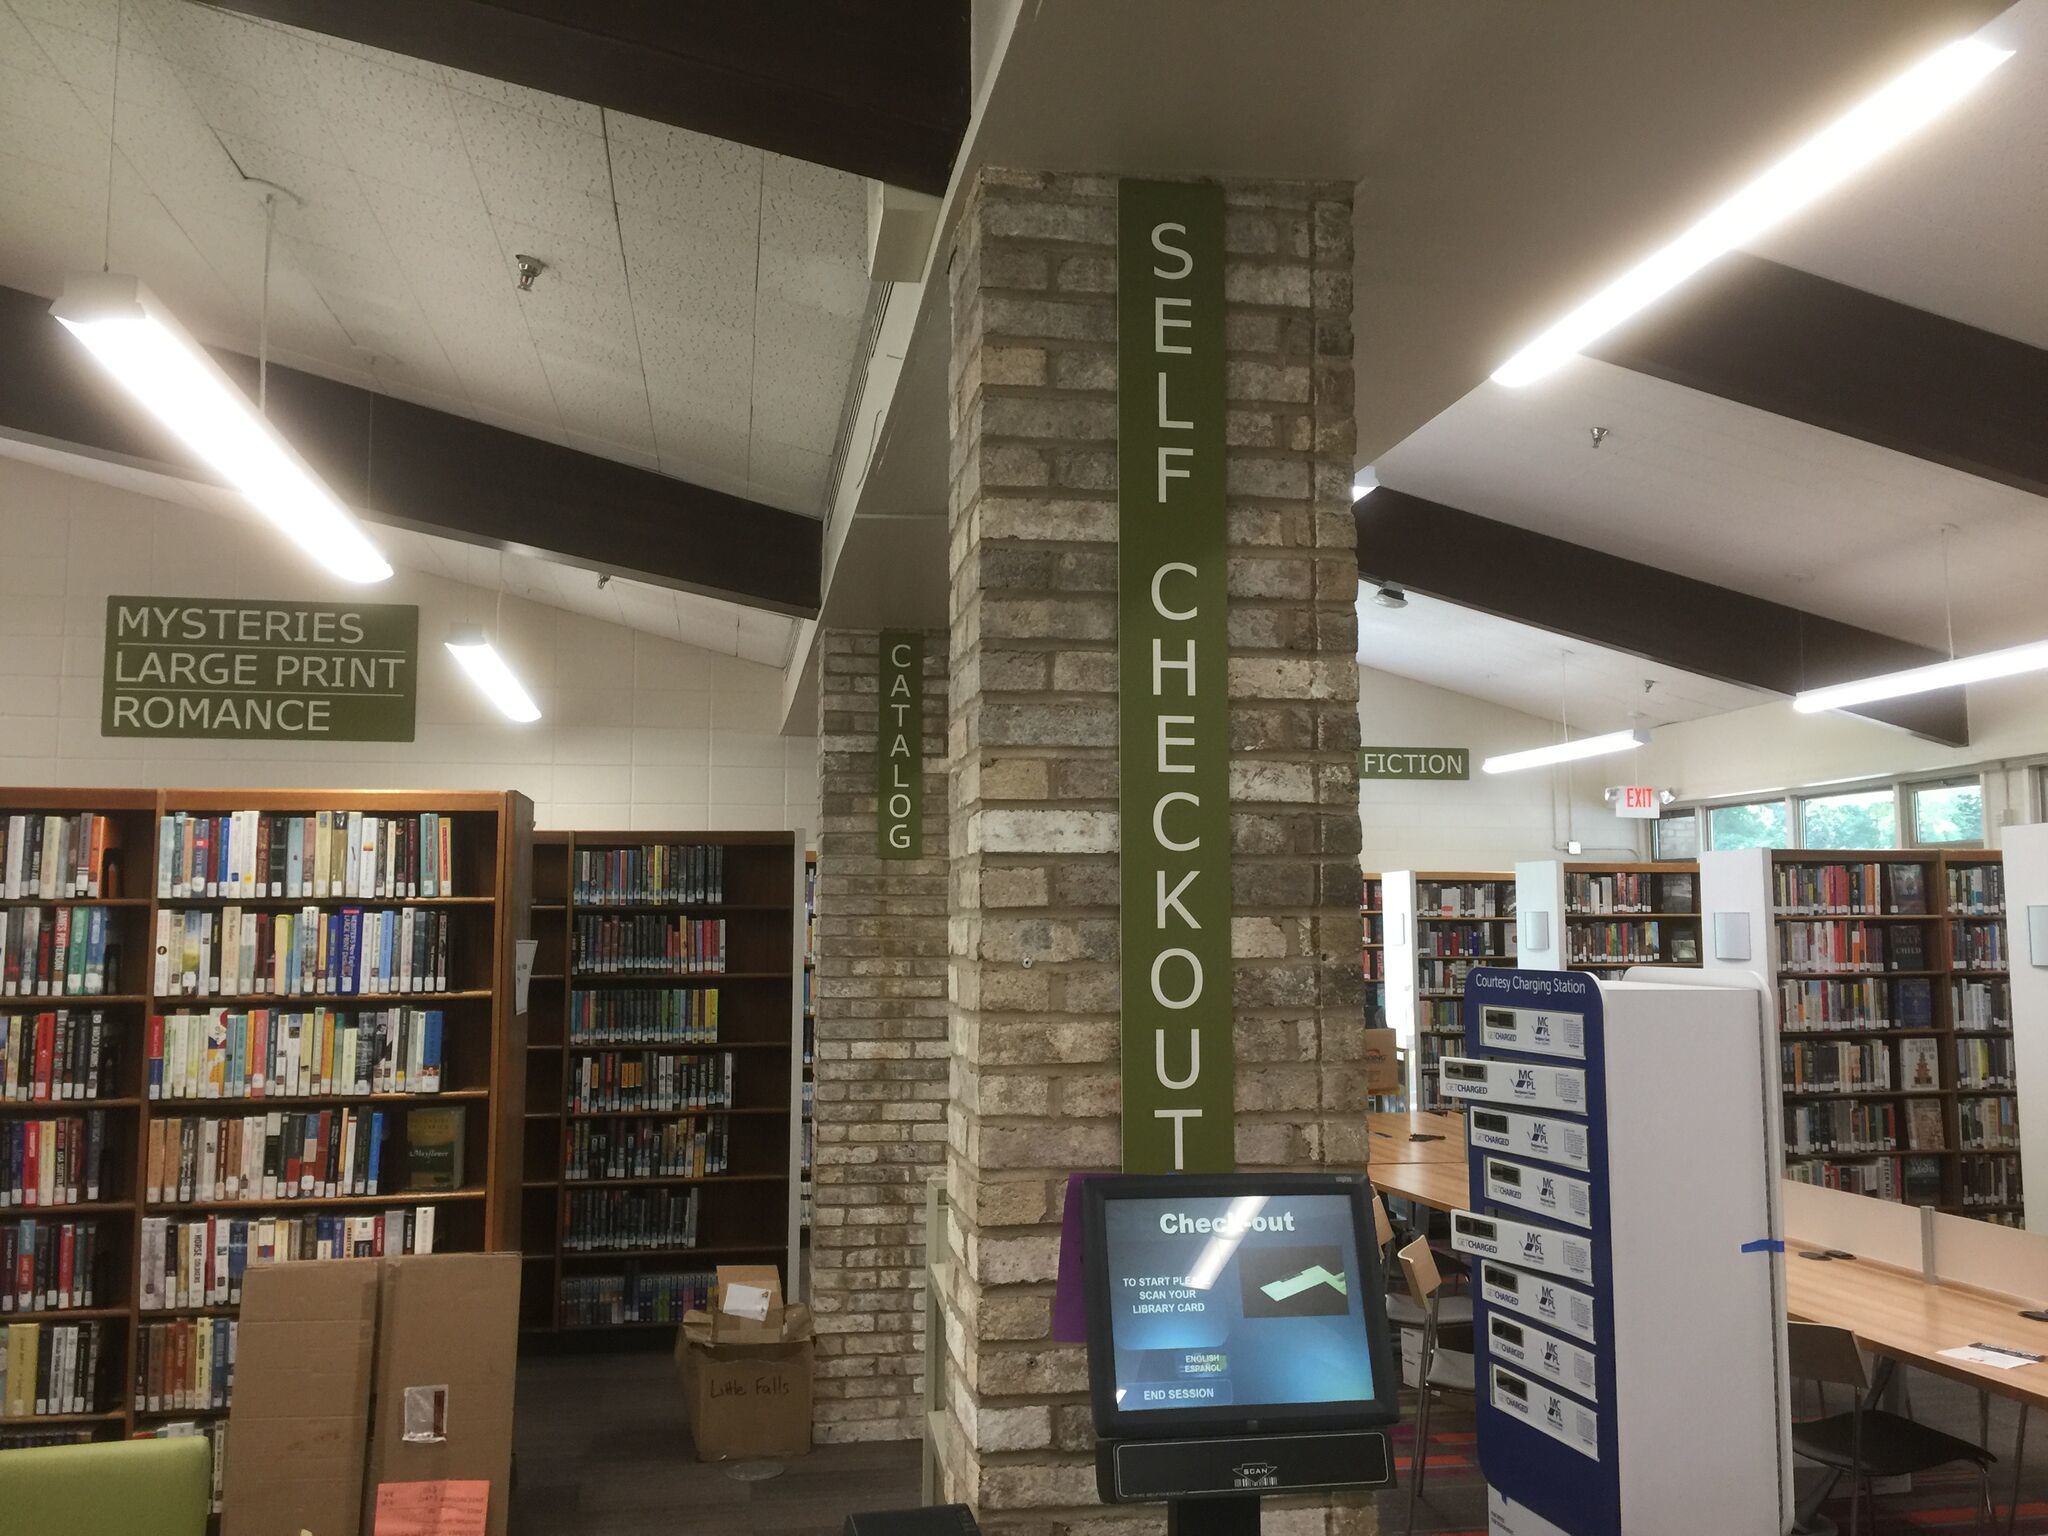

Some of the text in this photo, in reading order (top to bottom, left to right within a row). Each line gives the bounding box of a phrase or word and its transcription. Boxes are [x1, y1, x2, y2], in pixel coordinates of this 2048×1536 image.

[1151, 222, 1194, 503] SELF
[117, 605, 364, 644] MYSTERIES
[115, 651, 406, 688] LARGE PRINT
[113, 695, 331, 731] ROMANCE
[889, 644, 912, 849] CATALOG
[1364, 753, 1463, 775] FICTION
[1626, 787, 1653, 808] EXIT
[1150, 562, 1204, 1171] CHECKOUT
[1475, 973, 1586, 995] Courtesy Charging Station
[1518, 1069, 1534, 1081] MC
[1526, 1081, 1536, 1090] PL
[1527, 1232, 1542, 1245] MC
[1534, 1245, 1544, 1255] PL
[1122, 1278, 1137, 1287] TO
[1138, 1276, 1170, 1287] START
[1139, 1289, 1197, 1300] SCAN YOUR
[1132, 1302, 1205, 1314] LIBRARY CARD
[1185, 1354, 1220, 1363] ENGLISH
[1184, 1362, 1222, 1373] ESPAÑOL
[755, 1376, 790, 1396] Falls
[1143, 1388, 1214, 1401] END SESSION
[1243, 1468, 1268, 1476] SCAN
